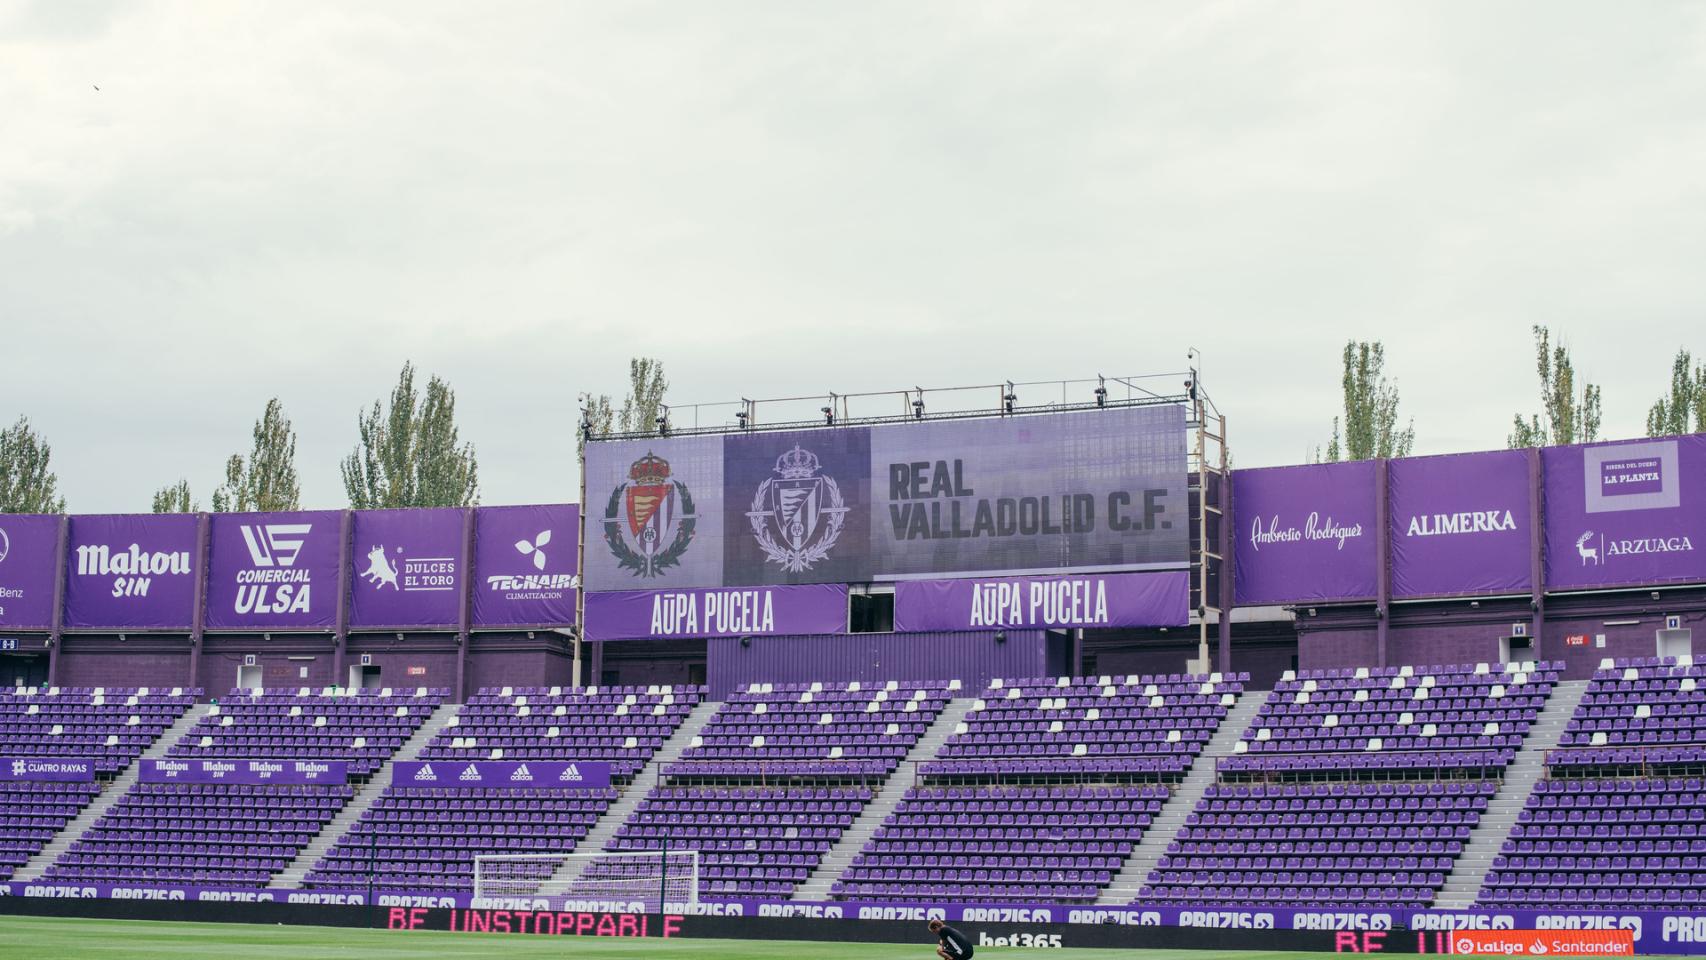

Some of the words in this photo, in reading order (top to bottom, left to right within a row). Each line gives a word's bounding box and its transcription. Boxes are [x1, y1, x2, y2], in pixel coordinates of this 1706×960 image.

[889, 459, 974, 500] REAL
[1604, 475, 1617, 484] LA
[1620, 472, 1659, 483] PLANTA
[889, 493, 1095, 541] VALLADOLID
[1108, 488, 1173, 531] C.F.
[1251, 514, 1301, 551] Ambrosio
[1305, 511, 1363, 550] Rodríguez
[1407, 510, 1517, 537] ALIMERKA
[1607, 537, 1694, 556] ARZUAGA
[76, 543, 191, 575] Mahou
[405, 563, 455, 574] DULCES
[236, 569, 311, 584] COMERCIAL
[405, 576, 419, 586] EL
[422, 575, 455, 586] TORO
[112, 577, 151, 597] SIN
[234, 585, 311, 614] ULSA
[506, 592, 562, 600] CLIMATIZACION
[1030, 579, 1108, 624] PUCELA
[704, 591, 775, 634] PUCELA
[28, 764, 60, 773] CUATRO
[61, 764, 87, 773] RAYAS
[156, 761, 189, 771] Mahou
[203, 761, 236, 771] Mahou
[250, 761, 283, 771] Mahou
[296, 761, 329, 771] Mahou
[979, 932, 1062, 948] bet365
[1477, 940, 1523, 954] LaLiga
[1552, 941, 1628, 953] Santander
